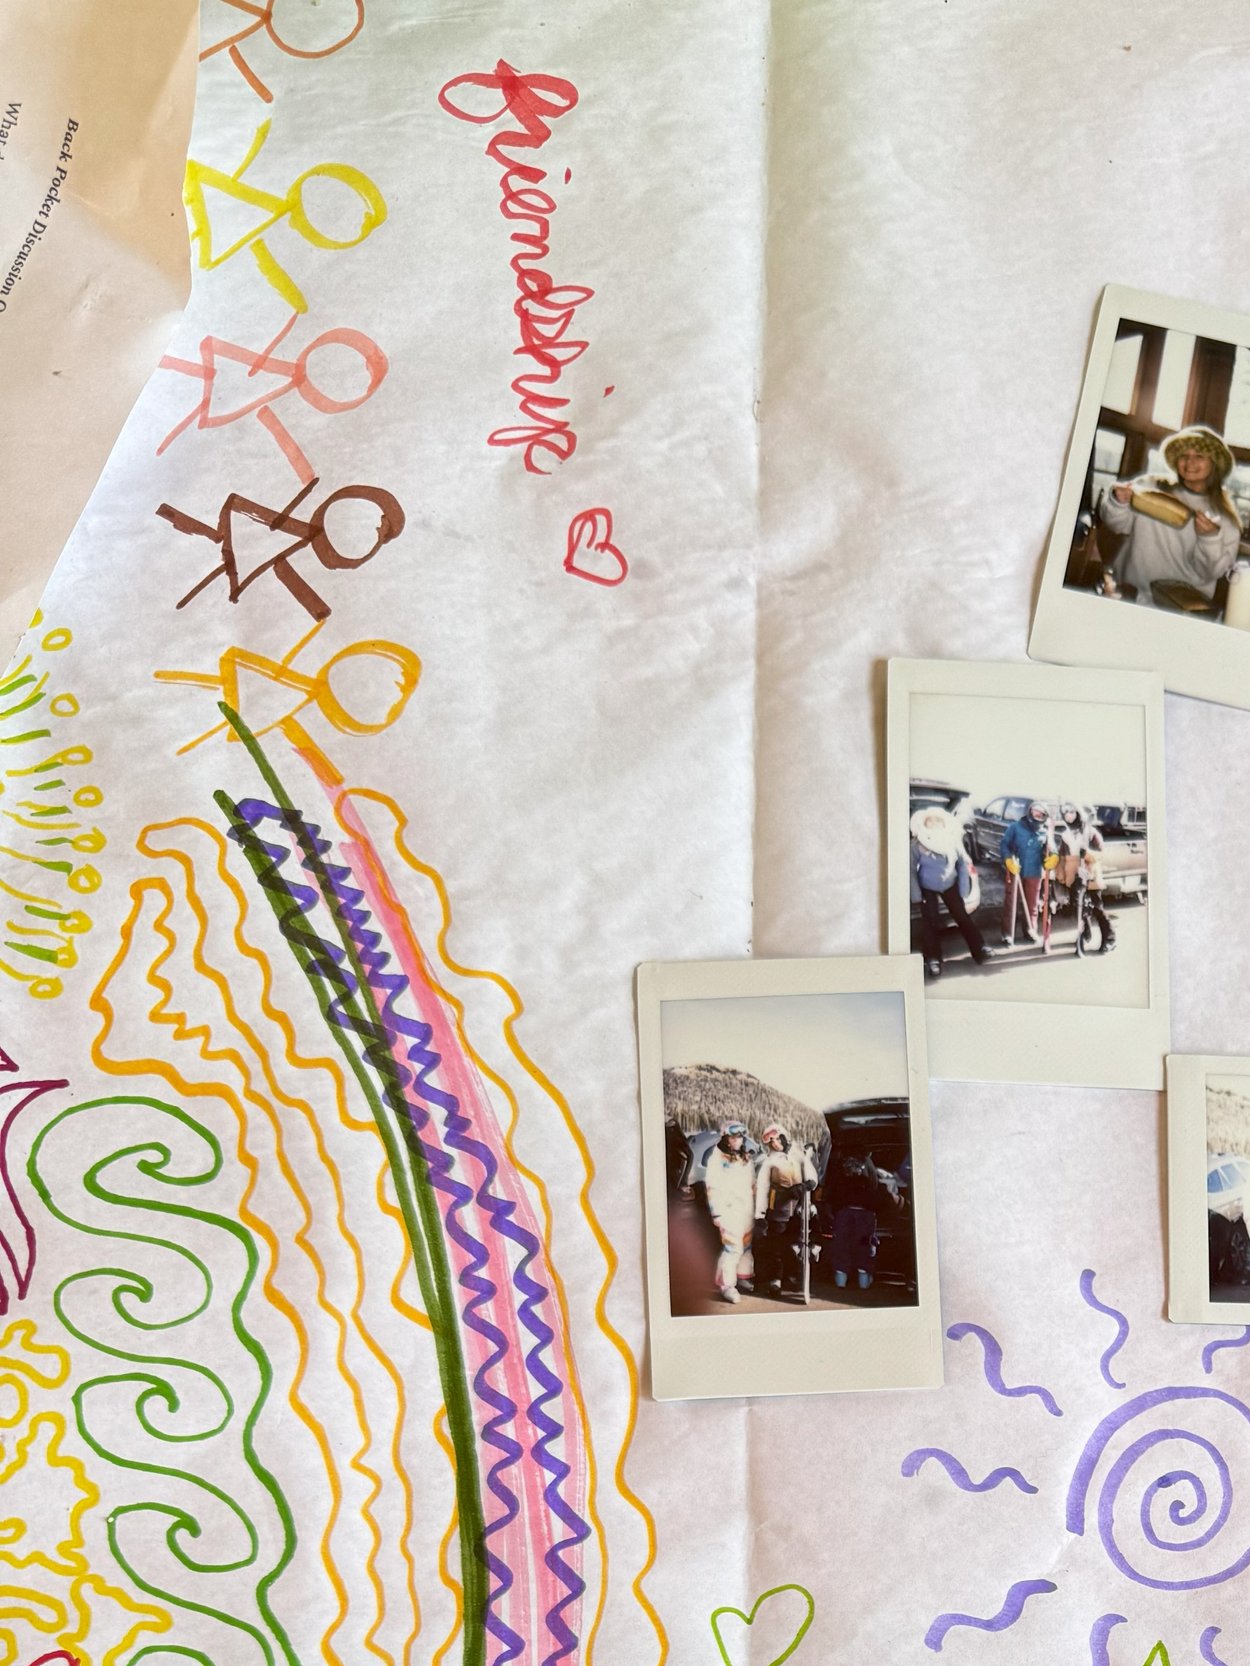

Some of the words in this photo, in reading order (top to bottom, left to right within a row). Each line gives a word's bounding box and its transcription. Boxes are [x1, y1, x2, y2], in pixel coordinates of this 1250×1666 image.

[59, 117, 79, 162] Back
[38, 165, 68, 218] Pocket
[0, 219, 47, 296] Discussion
[438, 58, 615, 474] friendship
